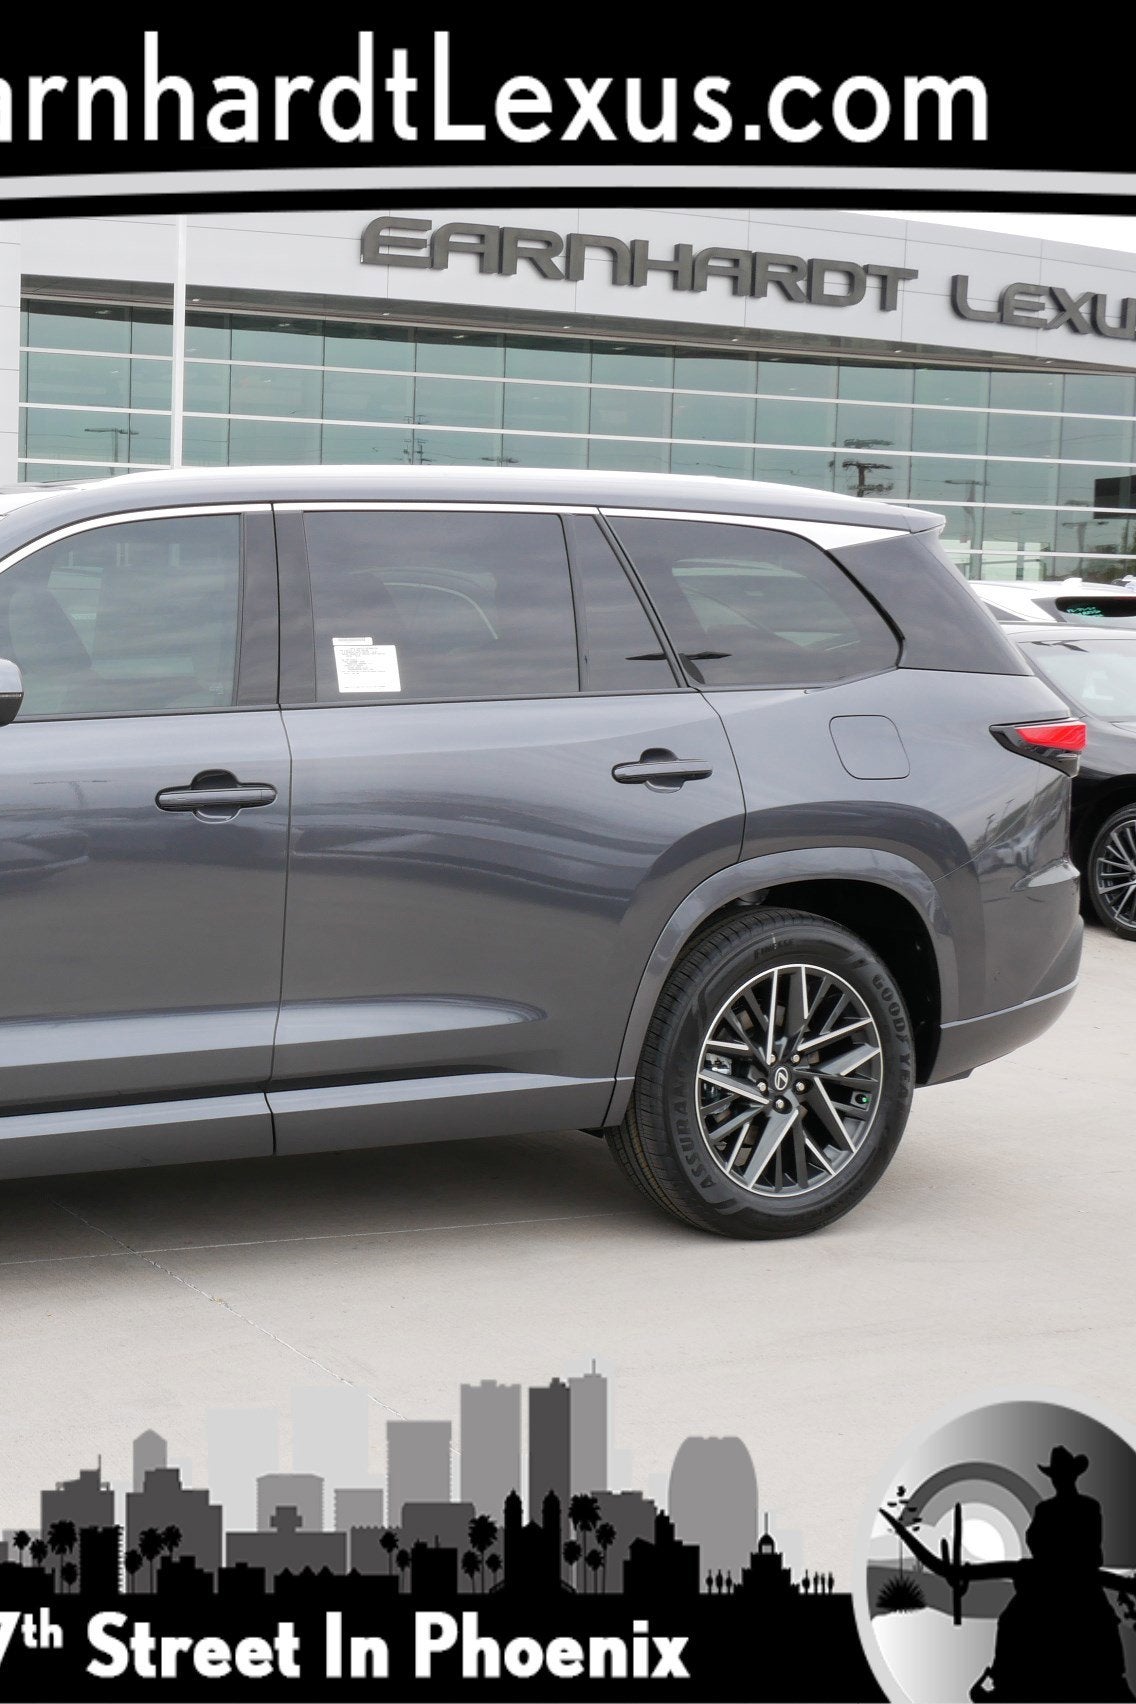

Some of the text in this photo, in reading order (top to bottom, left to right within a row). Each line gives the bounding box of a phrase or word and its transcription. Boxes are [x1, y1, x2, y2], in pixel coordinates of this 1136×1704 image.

[361, 216, 1136, 340] EARNHARDT LEXU
[672, 1074, 715, 1189] ASSURAN
